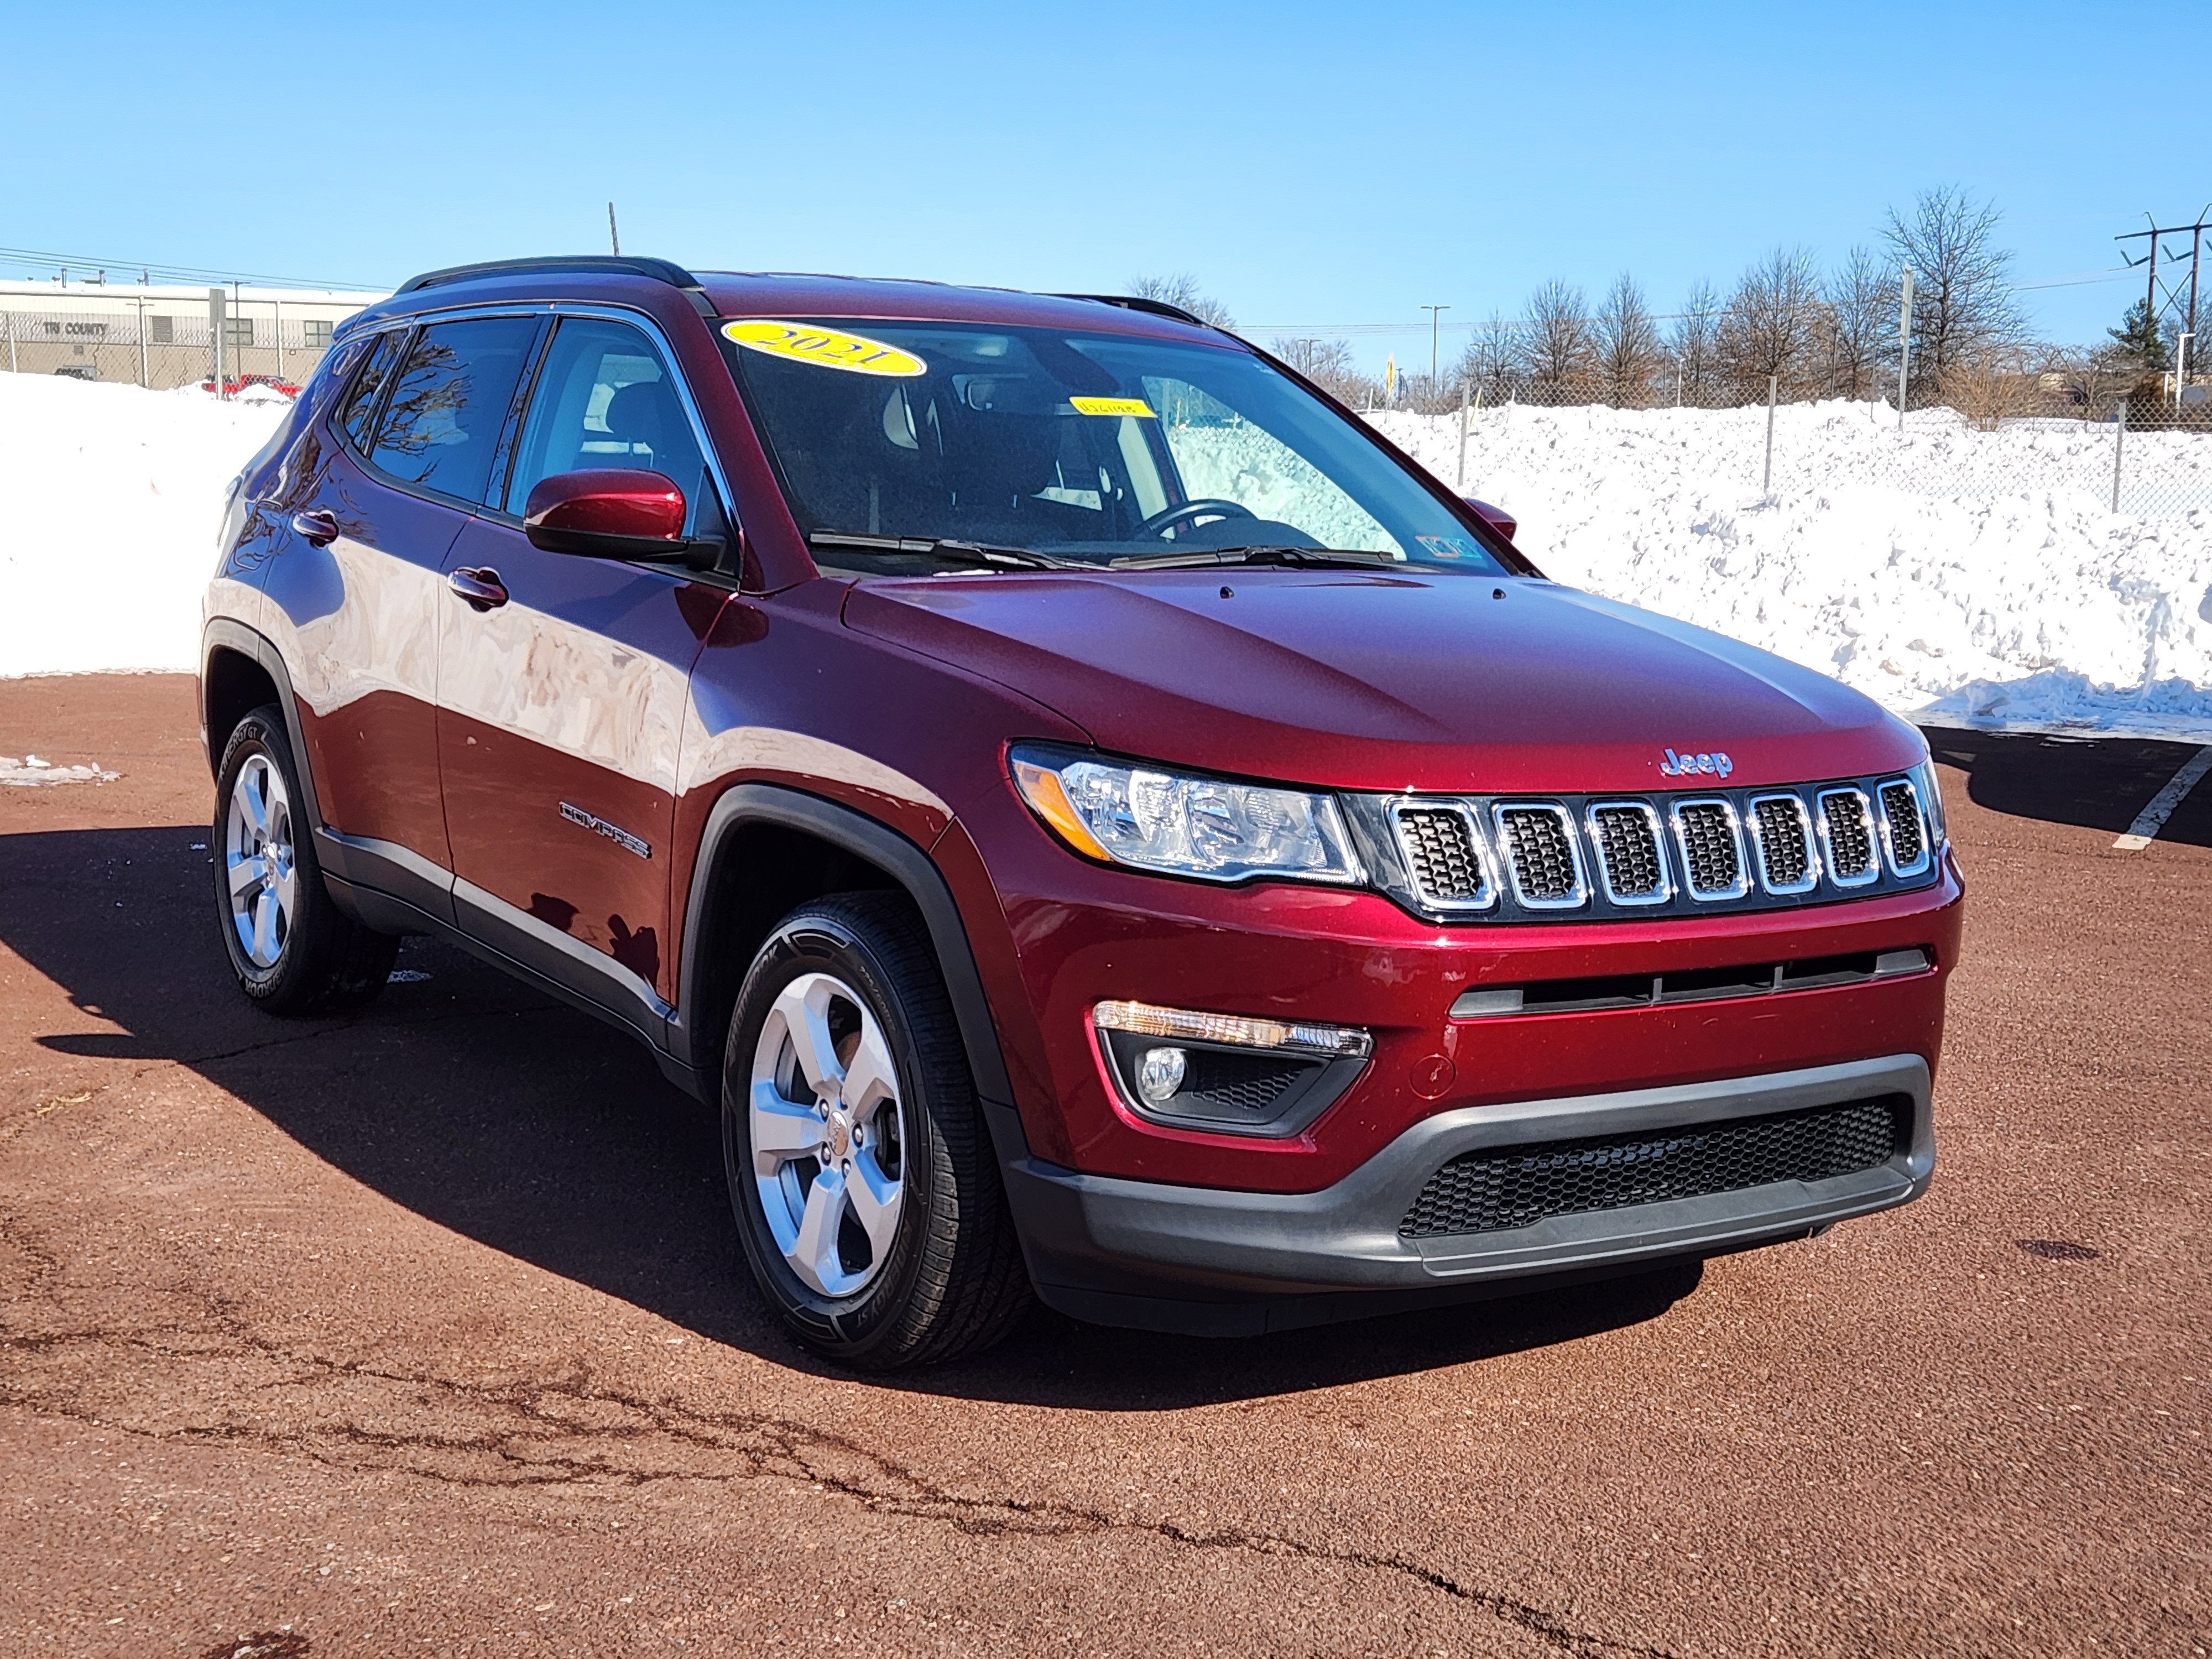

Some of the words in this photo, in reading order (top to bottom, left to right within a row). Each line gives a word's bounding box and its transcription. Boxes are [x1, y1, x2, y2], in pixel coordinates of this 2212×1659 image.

[65, 322, 109, 335] COUNTY
[755, 330, 893, 364] 2021
[248, 726, 258, 739] GT
[1660, 748, 1733, 779] Jeep
[559, 801, 652, 859] COMPASS
